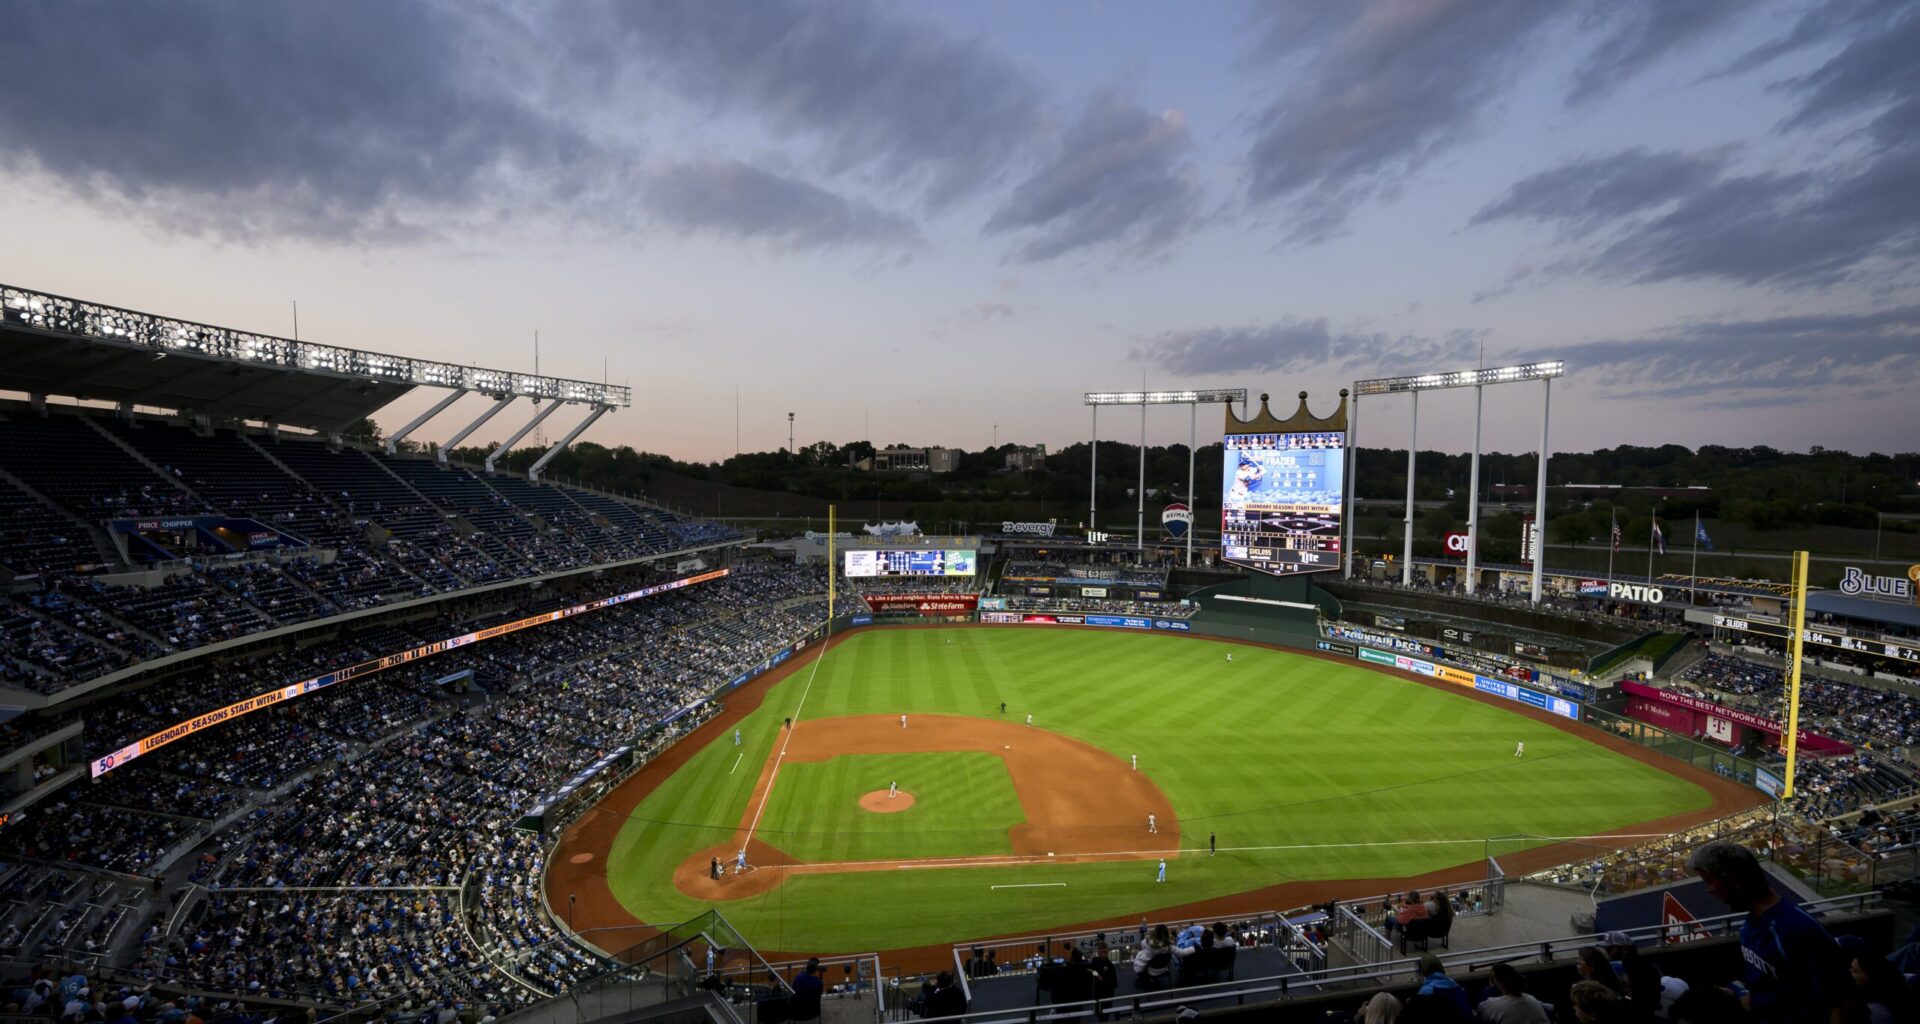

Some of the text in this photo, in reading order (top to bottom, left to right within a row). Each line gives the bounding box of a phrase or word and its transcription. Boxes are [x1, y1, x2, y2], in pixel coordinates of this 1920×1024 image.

[1015, 522, 1056, 537] evergy
[1088, 531, 1109, 544] Lite
[1611, 583, 1663, 604] PATIO
[1726, 618, 1748, 630] SLIDER
[1344, 631, 1421, 652] FOUNTAIN DECK
[1812, 633, 1823, 642] 84
[1856, 640, 1862, 650] 4
[1475, 682, 1505, 694] AIRLINES
[1480, 679, 1506, 689] UNITED
[145, 691, 283, 750] LEGENDARY SEASONS START WITH A
[1659, 691, 1807, 740] NOW THE BEST NETWORK IN AMCA
[100, 755, 114, 772] 50
